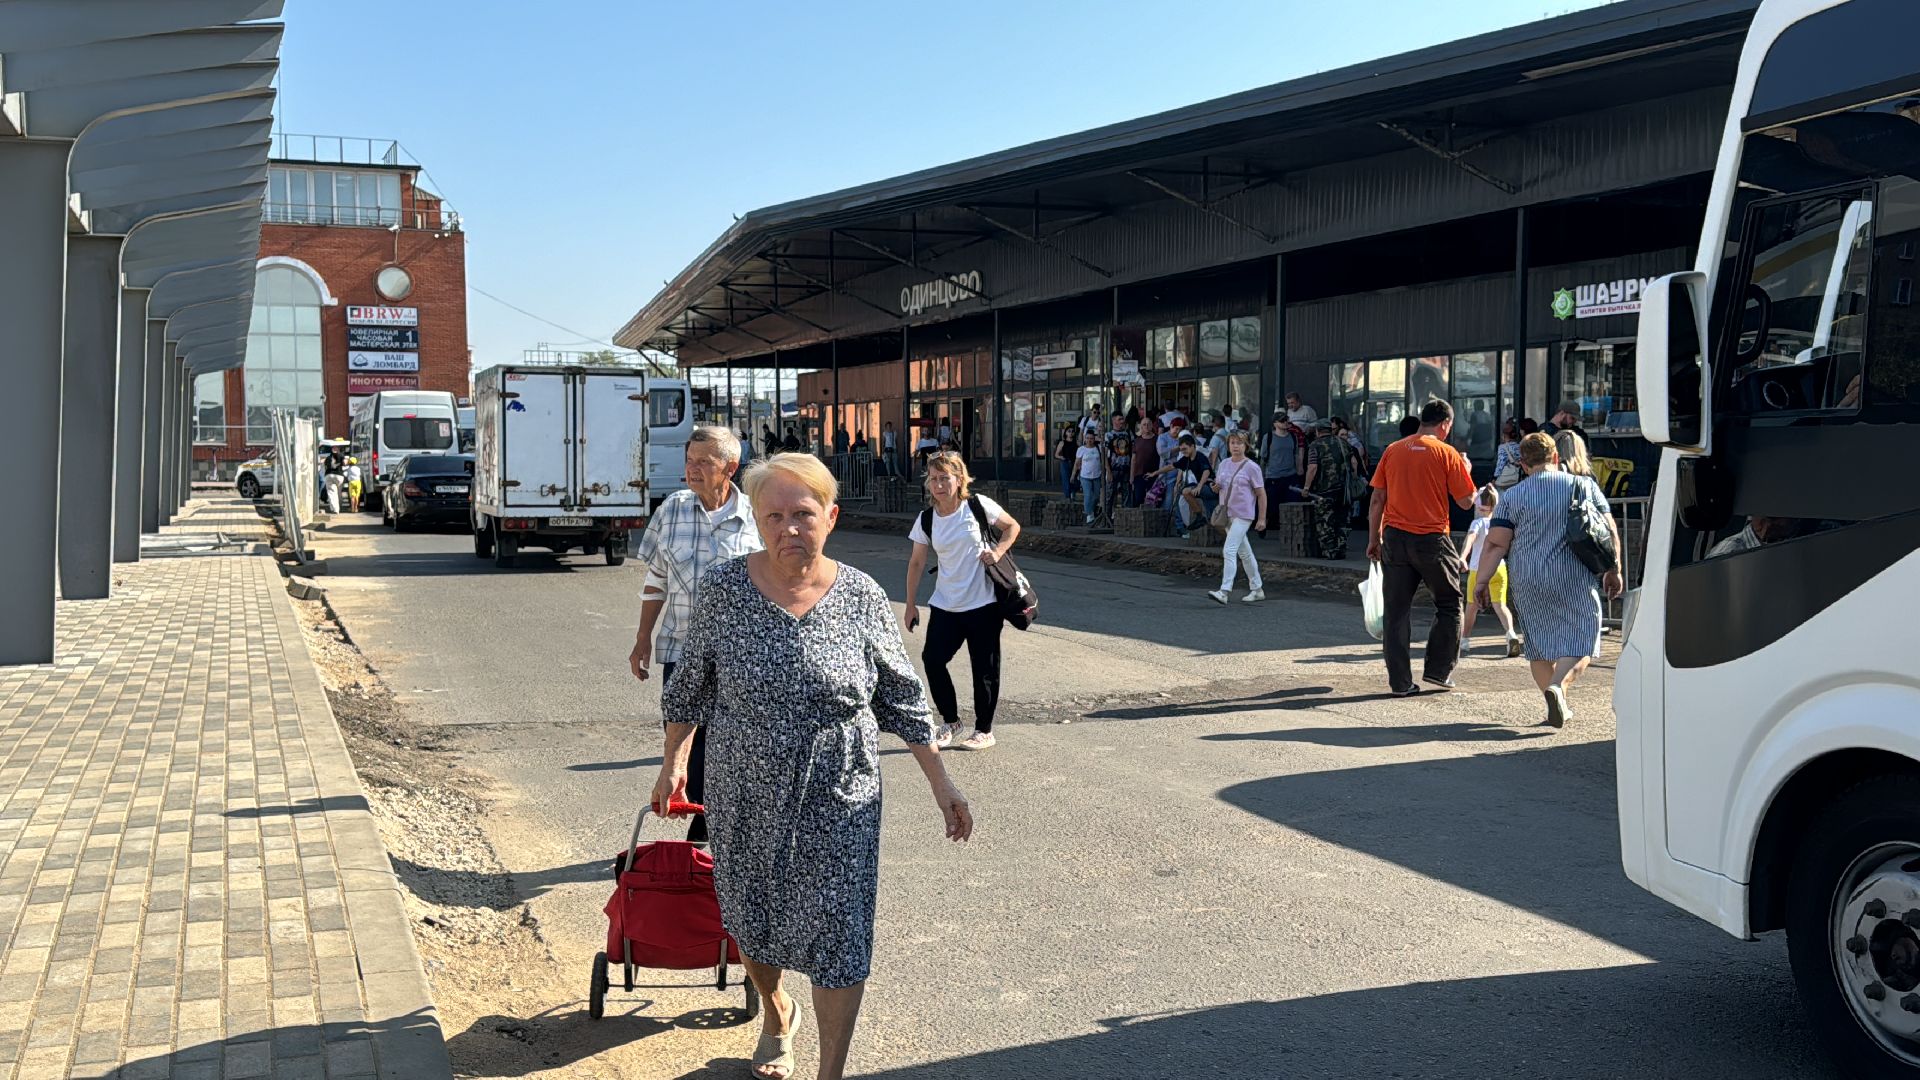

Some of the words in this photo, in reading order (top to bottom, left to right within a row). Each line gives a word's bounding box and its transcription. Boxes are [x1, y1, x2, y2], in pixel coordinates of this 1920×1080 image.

[900, 270, 981, 315] ОДИНЦОВО
[1575, 277, 1656, 306] ШАУРМ
[363, 308, 404, 319] BRW
[1580, 306, 1607, 315] НАПИТКИ
[1608, 303, 1636, 313] ВЫПЕЧКА
[406, 331, 413, 342] 1
[372, 361, 417, 369] ЛОМБАРД
[350, 378, 382, 386] МНОГО
[384, 378, 417, 387] МЕБЕЛИ
